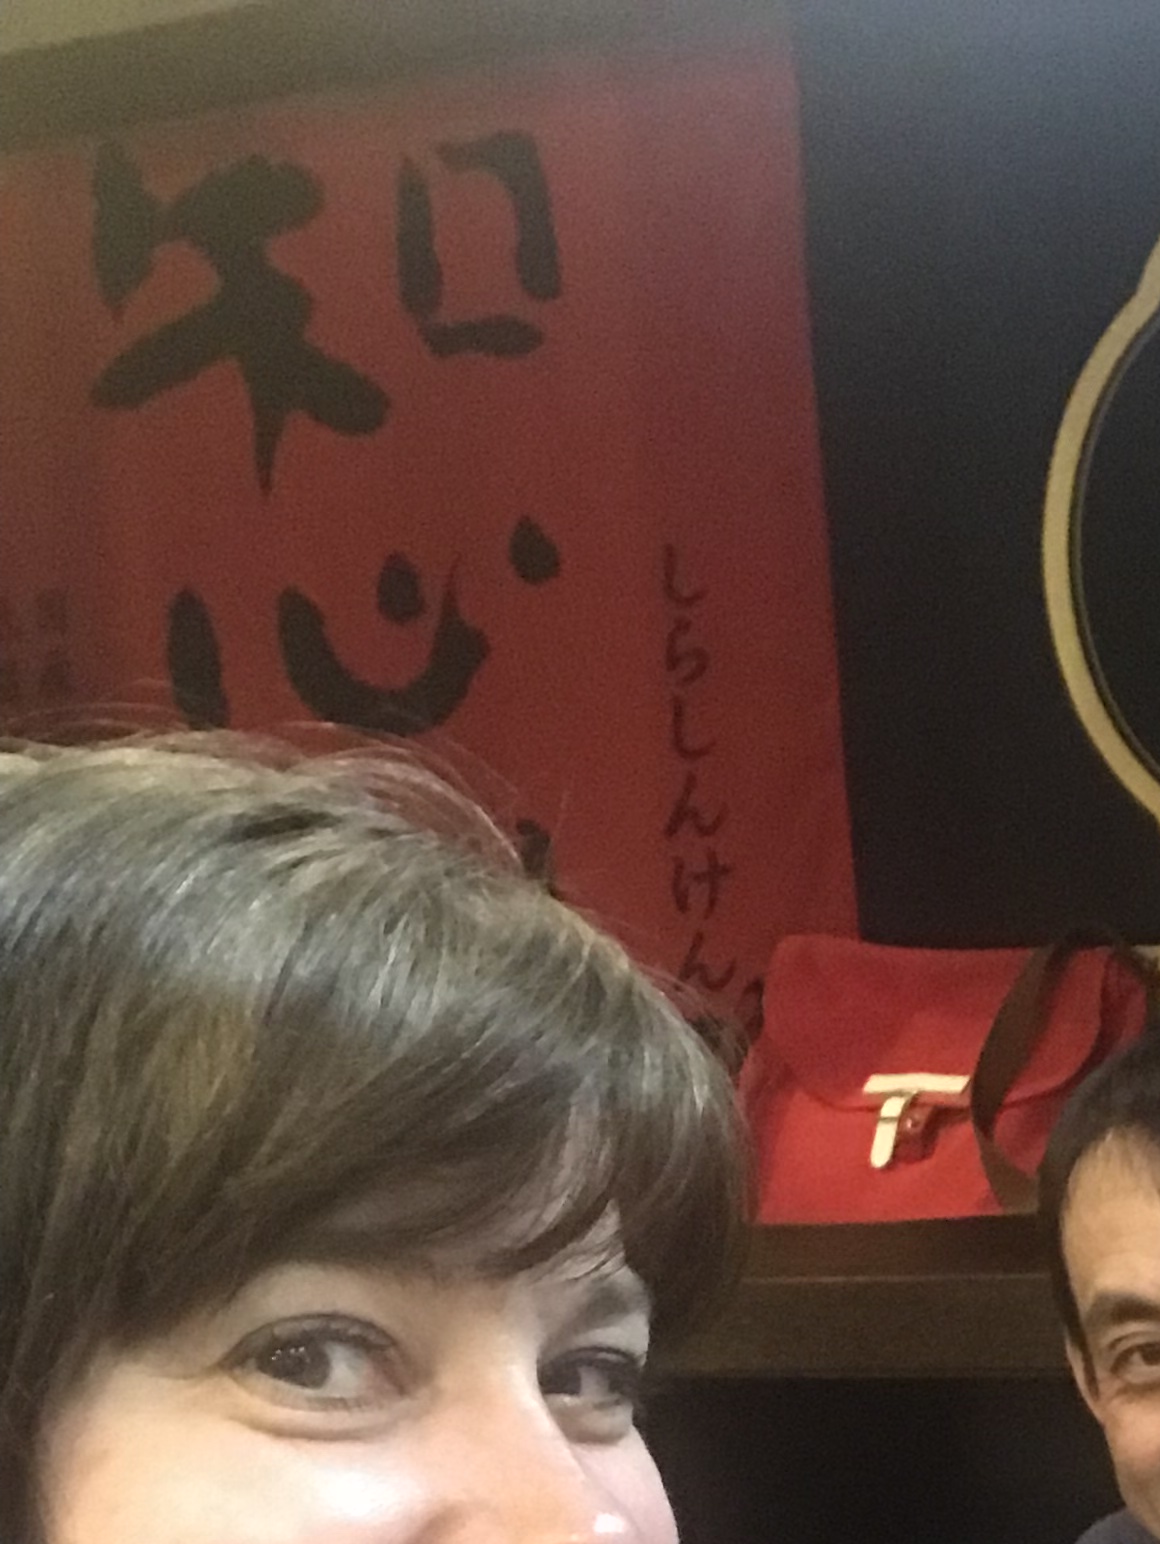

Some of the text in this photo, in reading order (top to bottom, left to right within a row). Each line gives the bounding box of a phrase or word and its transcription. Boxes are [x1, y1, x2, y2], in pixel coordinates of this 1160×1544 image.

[90, 128, 563, 892] 知心
[662, 543, 738, 992] しらしんけん
